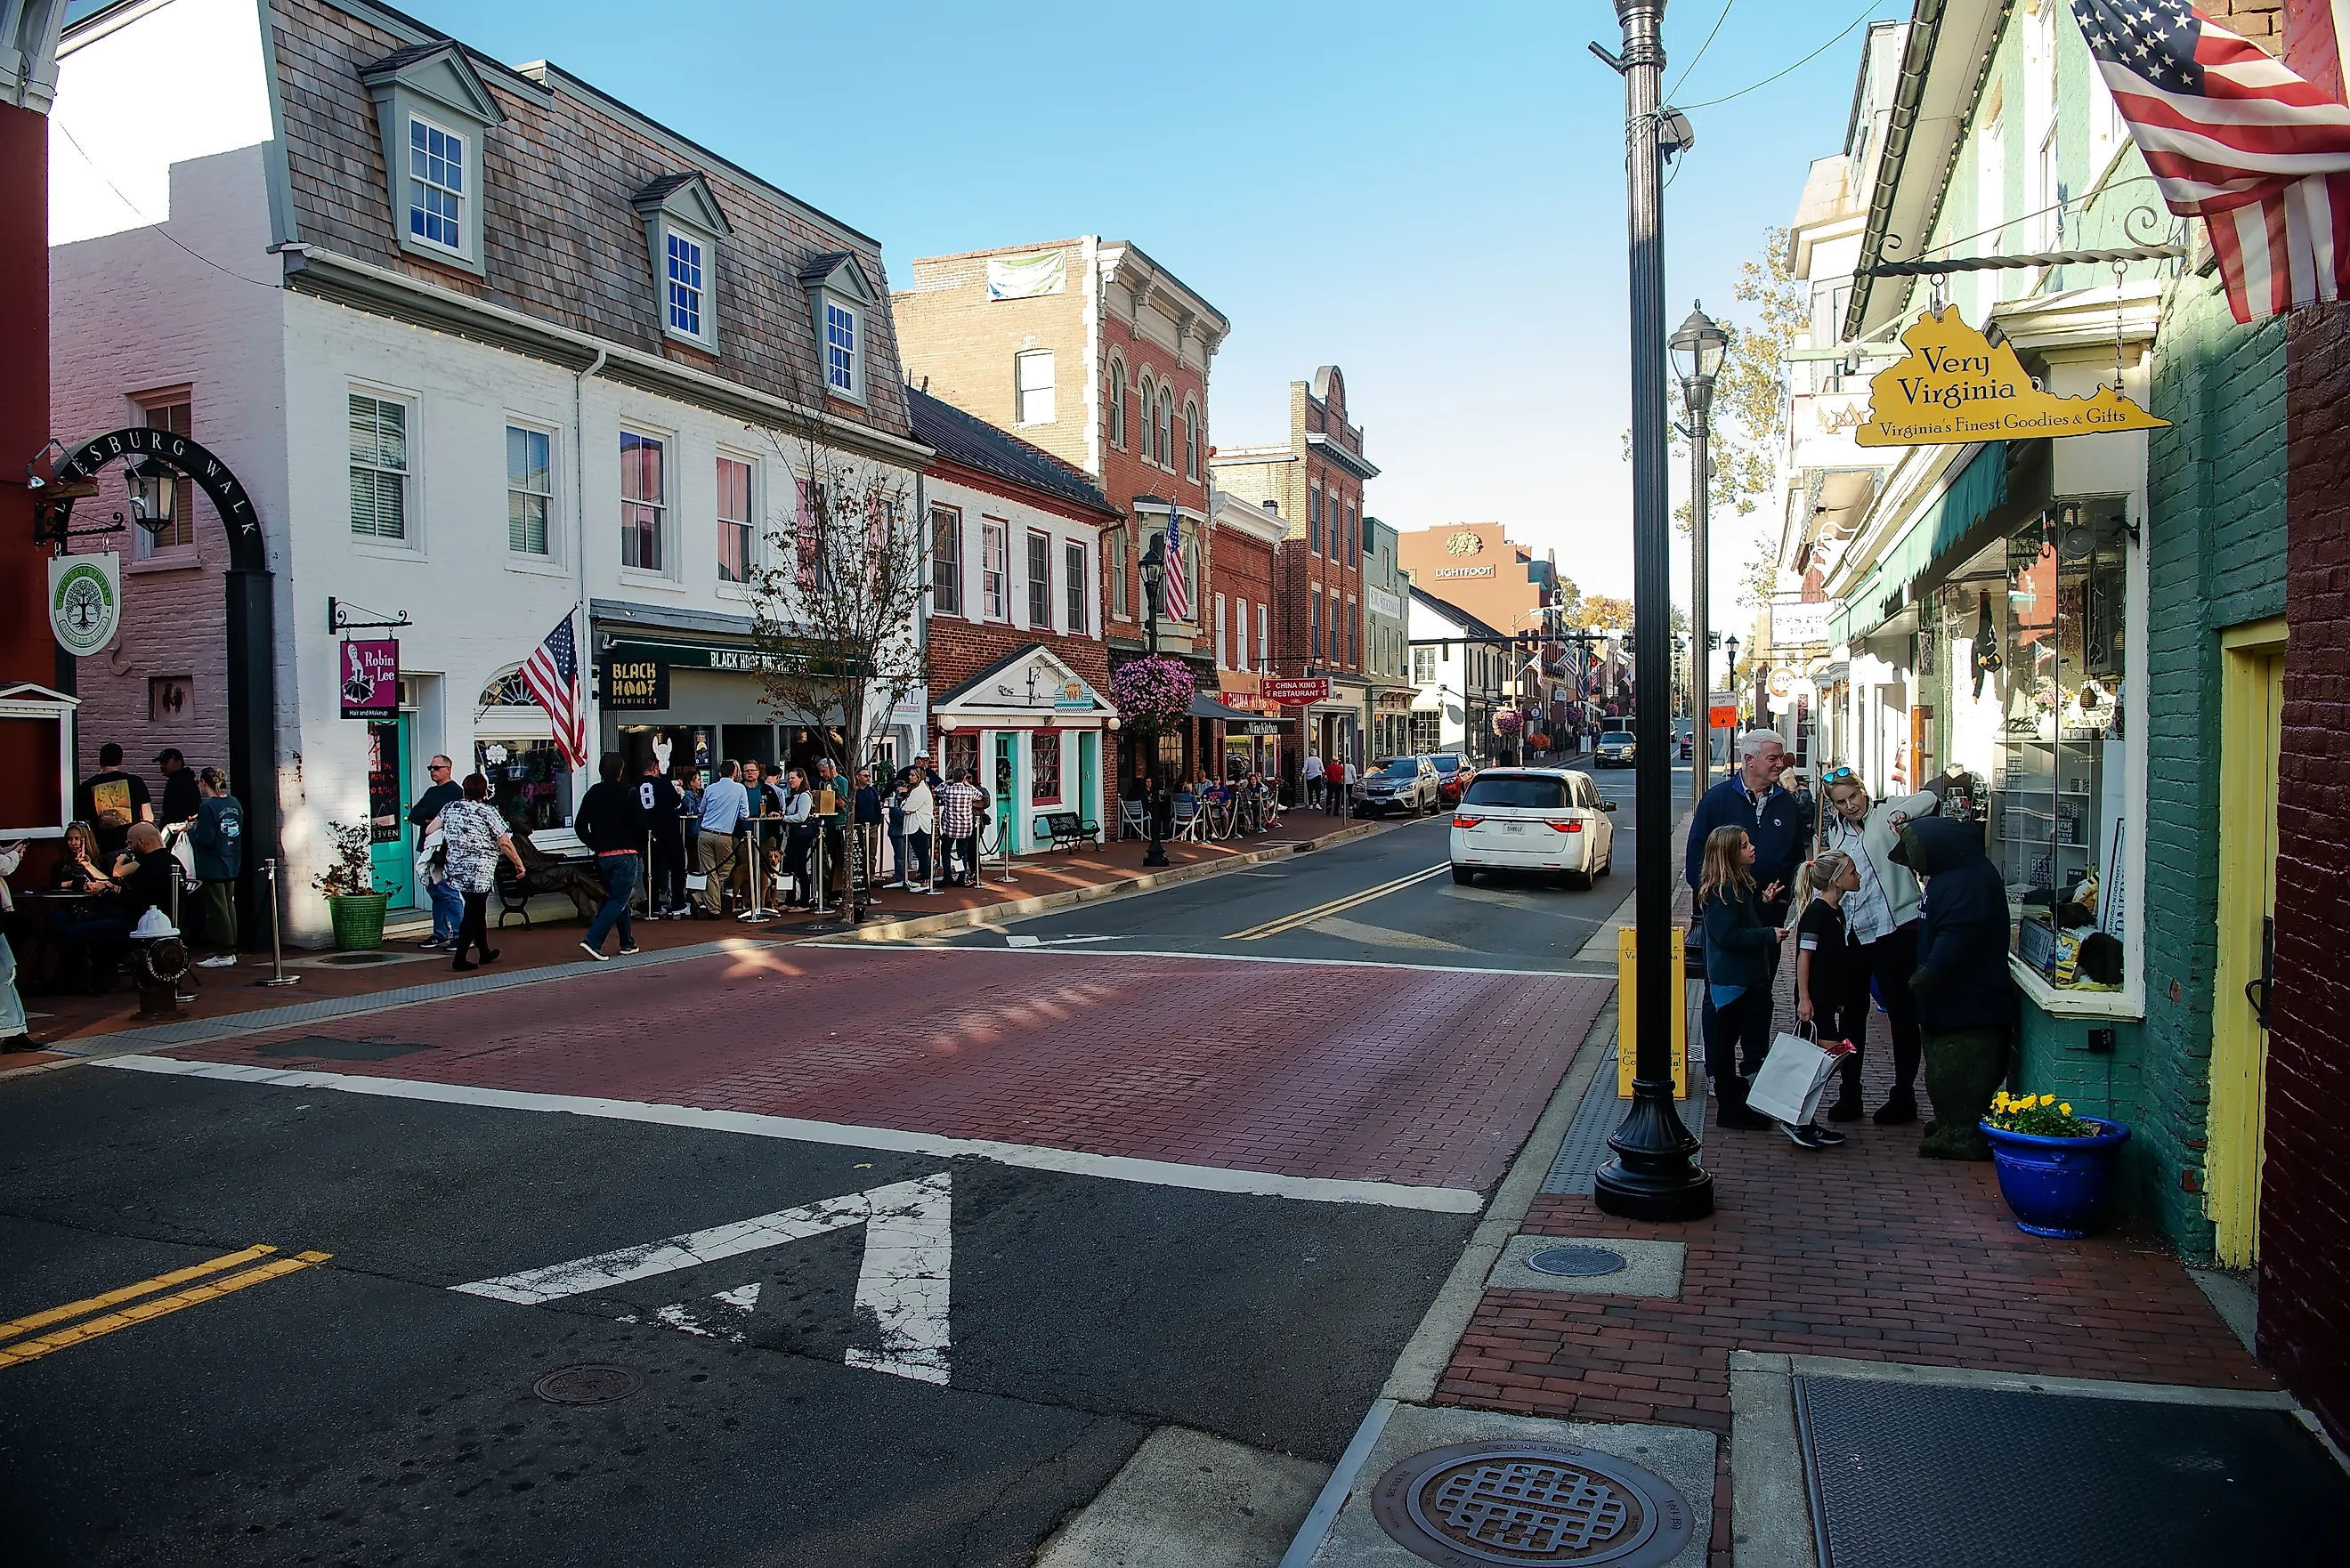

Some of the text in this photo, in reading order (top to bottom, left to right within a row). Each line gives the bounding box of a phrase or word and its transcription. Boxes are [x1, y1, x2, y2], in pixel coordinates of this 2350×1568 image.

[1920, 345, 1989, 376] Very
[1897, 378, 2016, 409] Virginia
[1879, 408, 2126, 439] Virginia's Finest Goodies & Gifts
[55, 432, 256, 535] LESBURG WALK
[1435, 566, 1493, 578] LIGHTFOOT
[57, 568, 110, 602] GREEN TREE TAVERN
[364, 649, 394, 667] Robin
[710, 651, 738, 668] BLACK
[377, 666, 395, 682] Lee
[612, 662, 656, 679] BLACK
[612, 680, 656, 697] HOOF
[1228, 692, 1248, 708] CHINA
[369, 709, 388, 717] Makeup
[1248, 722, 1261, 734] Wine
[640, 783, 656, 809] 8
[2031, 859, 2053, 872] BEST
[2030, 871, 2053, 883] BEERS
[2112, 865, 2121, 903] LOUDOUN
[1541, 1443, 1581, 1457] MADE
[1670, 1516, 1681, 1530] USF
